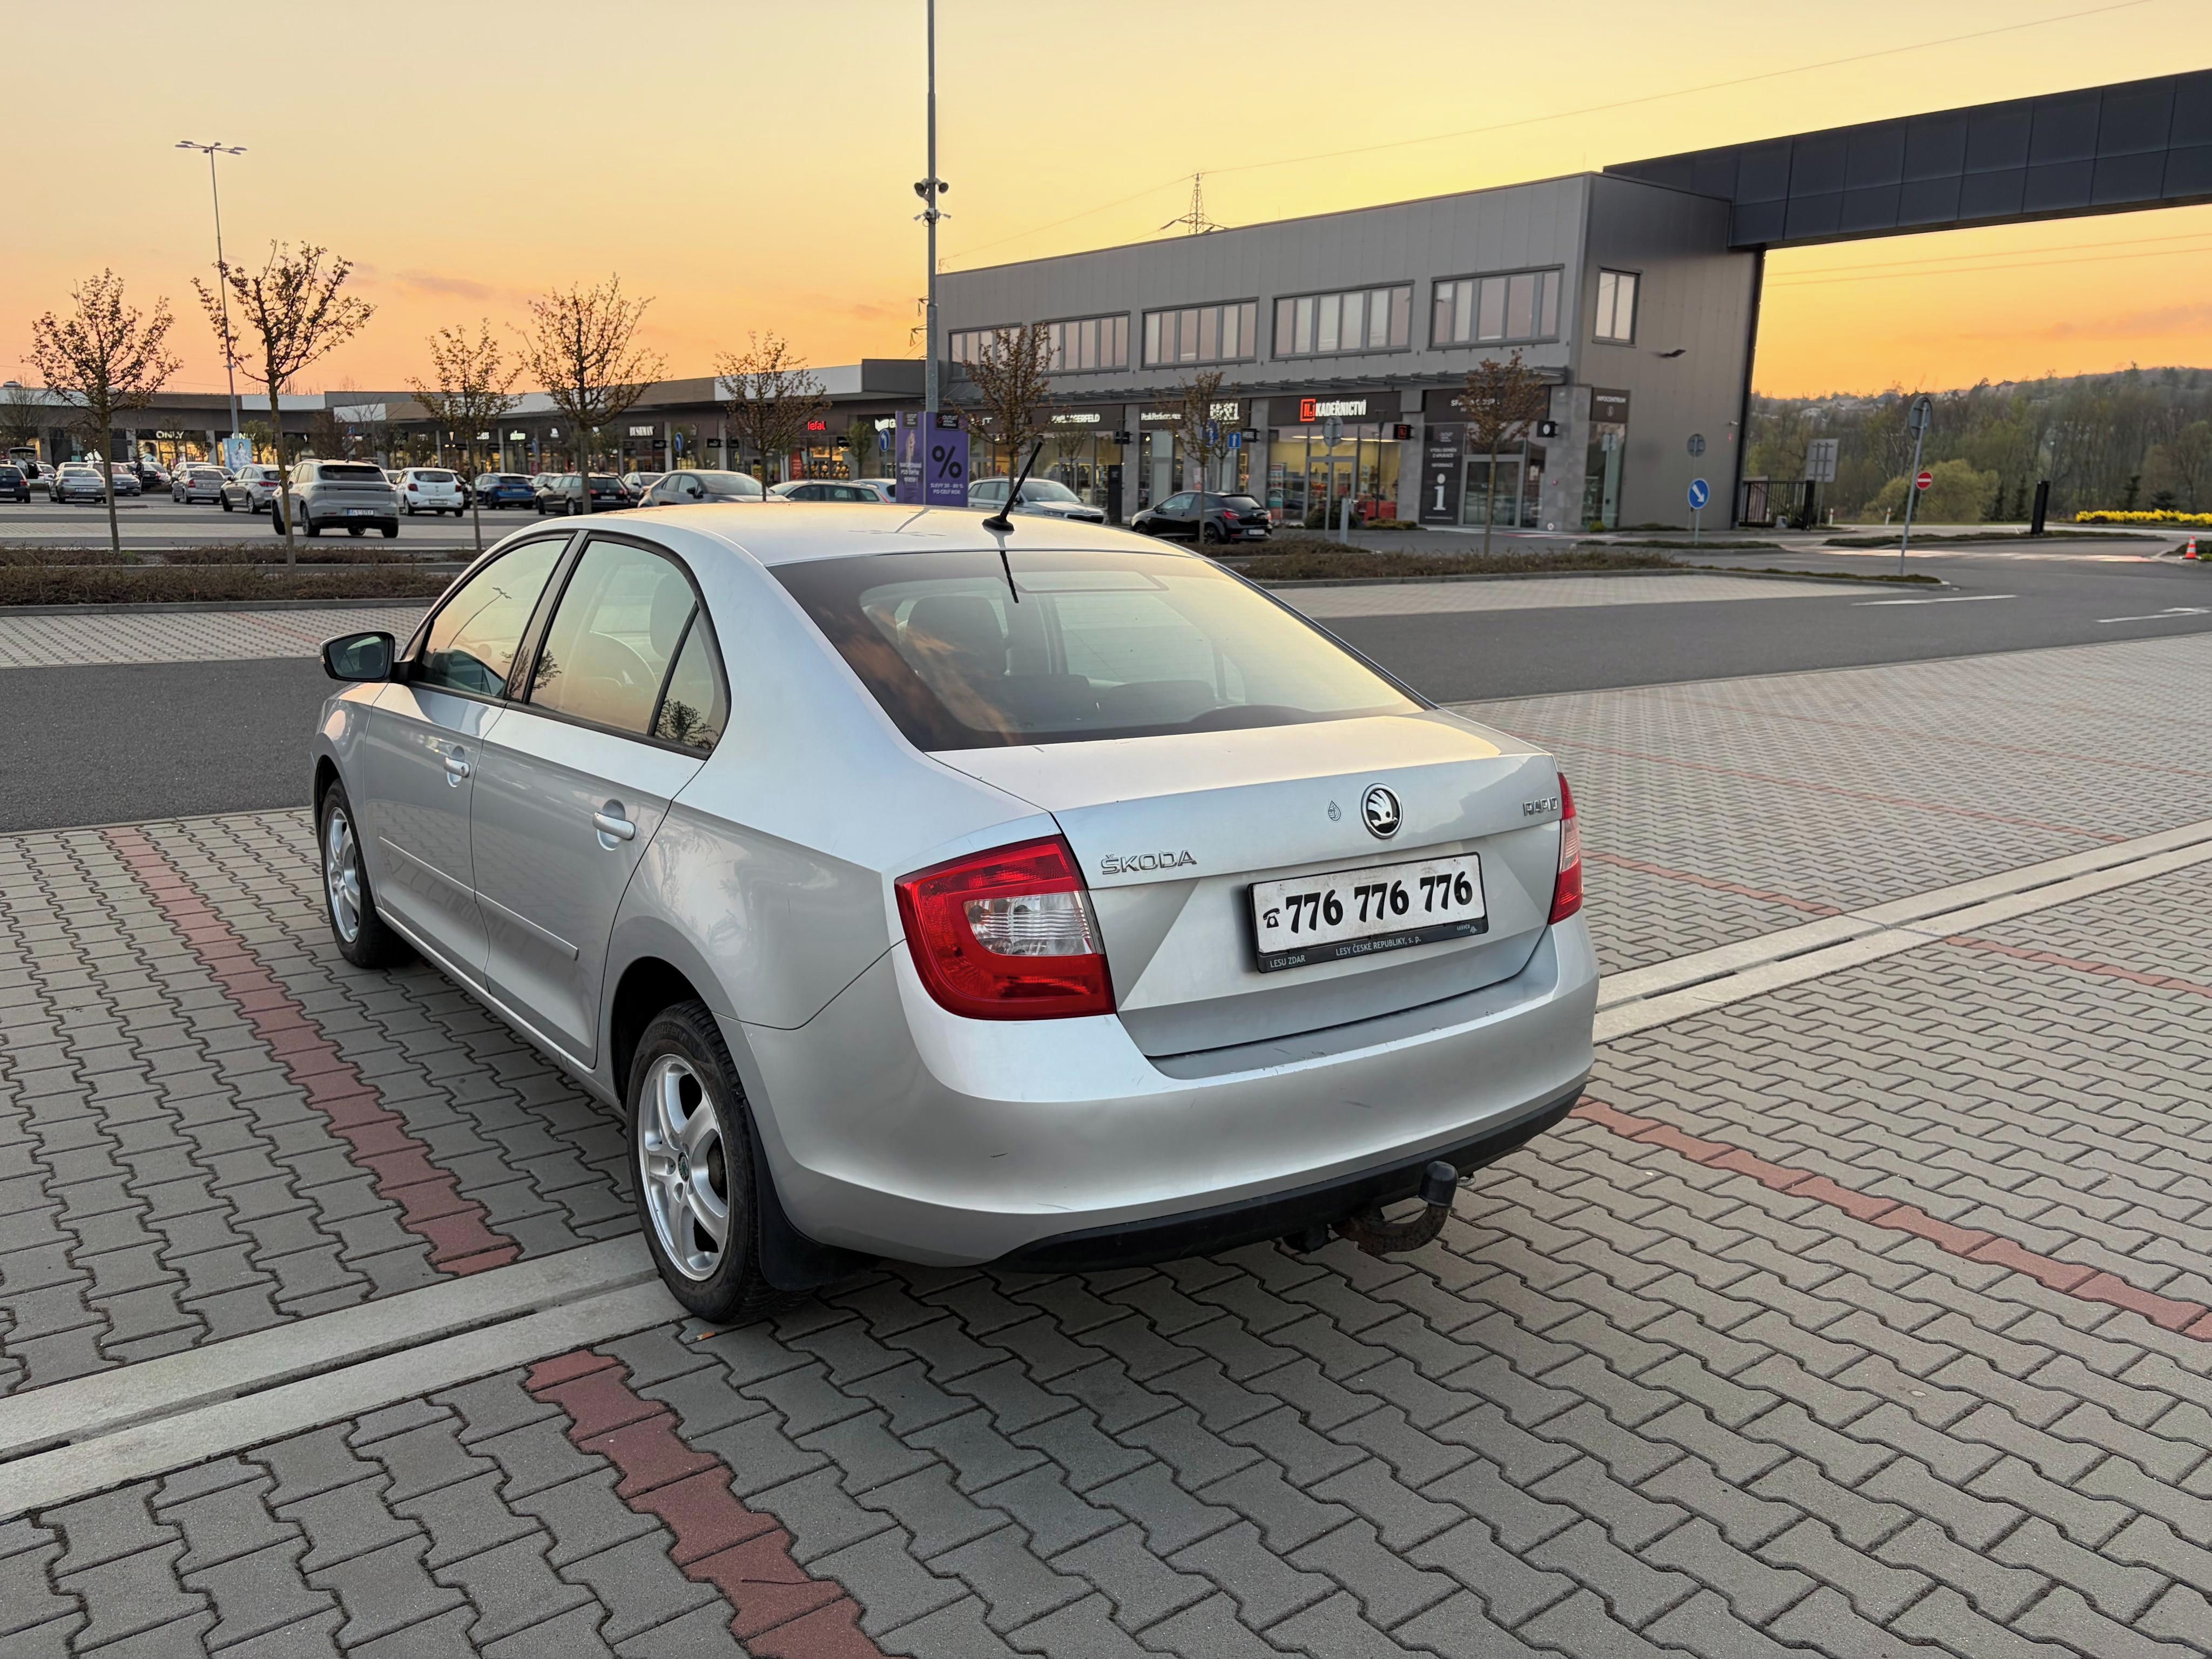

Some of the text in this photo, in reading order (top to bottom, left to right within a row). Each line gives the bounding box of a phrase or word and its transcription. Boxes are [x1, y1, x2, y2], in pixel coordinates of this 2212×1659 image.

[156, 430, 184, 439] ONLY
[1101, 849, 1197, 875] ŠKODA
[1286, 871, 1473, 934] 776 776 776
[1336, 947, 1351, 956] LESY
[1352, 941, 1372, 953] ČESKÉ
[1373, 936, 1407, 949] REPUBLIKY,
[1270, 955, 1306, 968] LESU ZDAR
